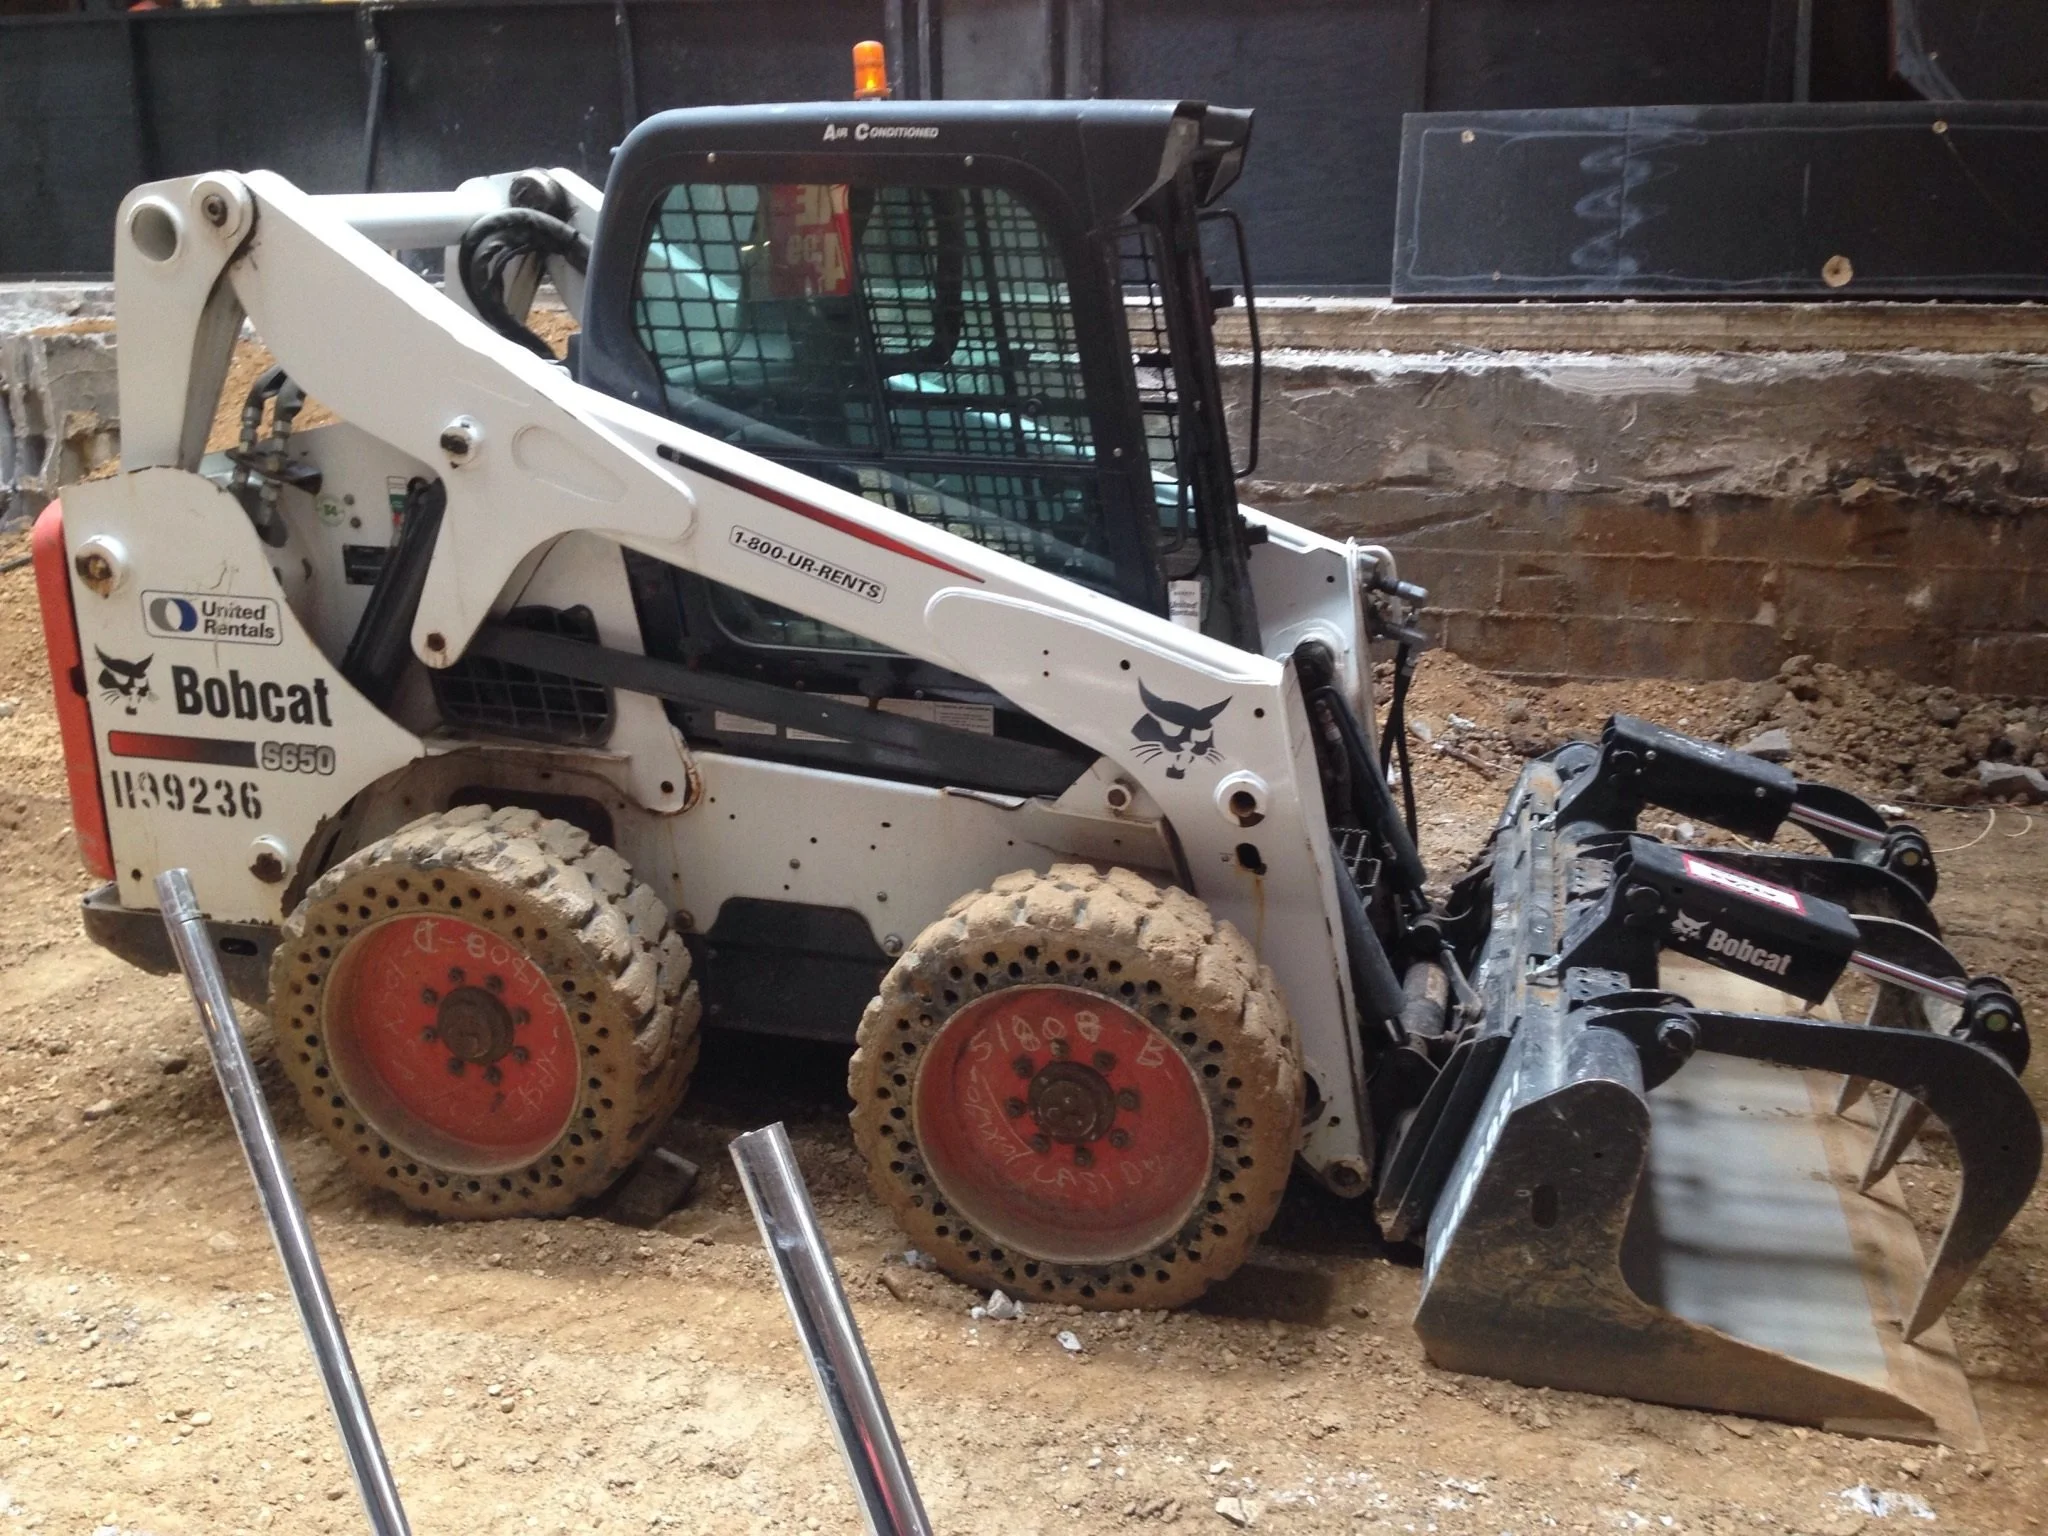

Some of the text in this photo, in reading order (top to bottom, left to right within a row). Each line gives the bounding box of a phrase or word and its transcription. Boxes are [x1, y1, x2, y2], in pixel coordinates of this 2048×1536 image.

[854, 122, 940, 141] CONDITIONED
[734, 530, 882, 599] 1-800-UR-RENTS
[201, 600, 267, 621] United
[203, 618, 276, 639] Rentals
[171, 664, 334, 727] Bobcat
[260, 740, 336, 776] S650
[1706, 927, 1793, 976] Bobcat
